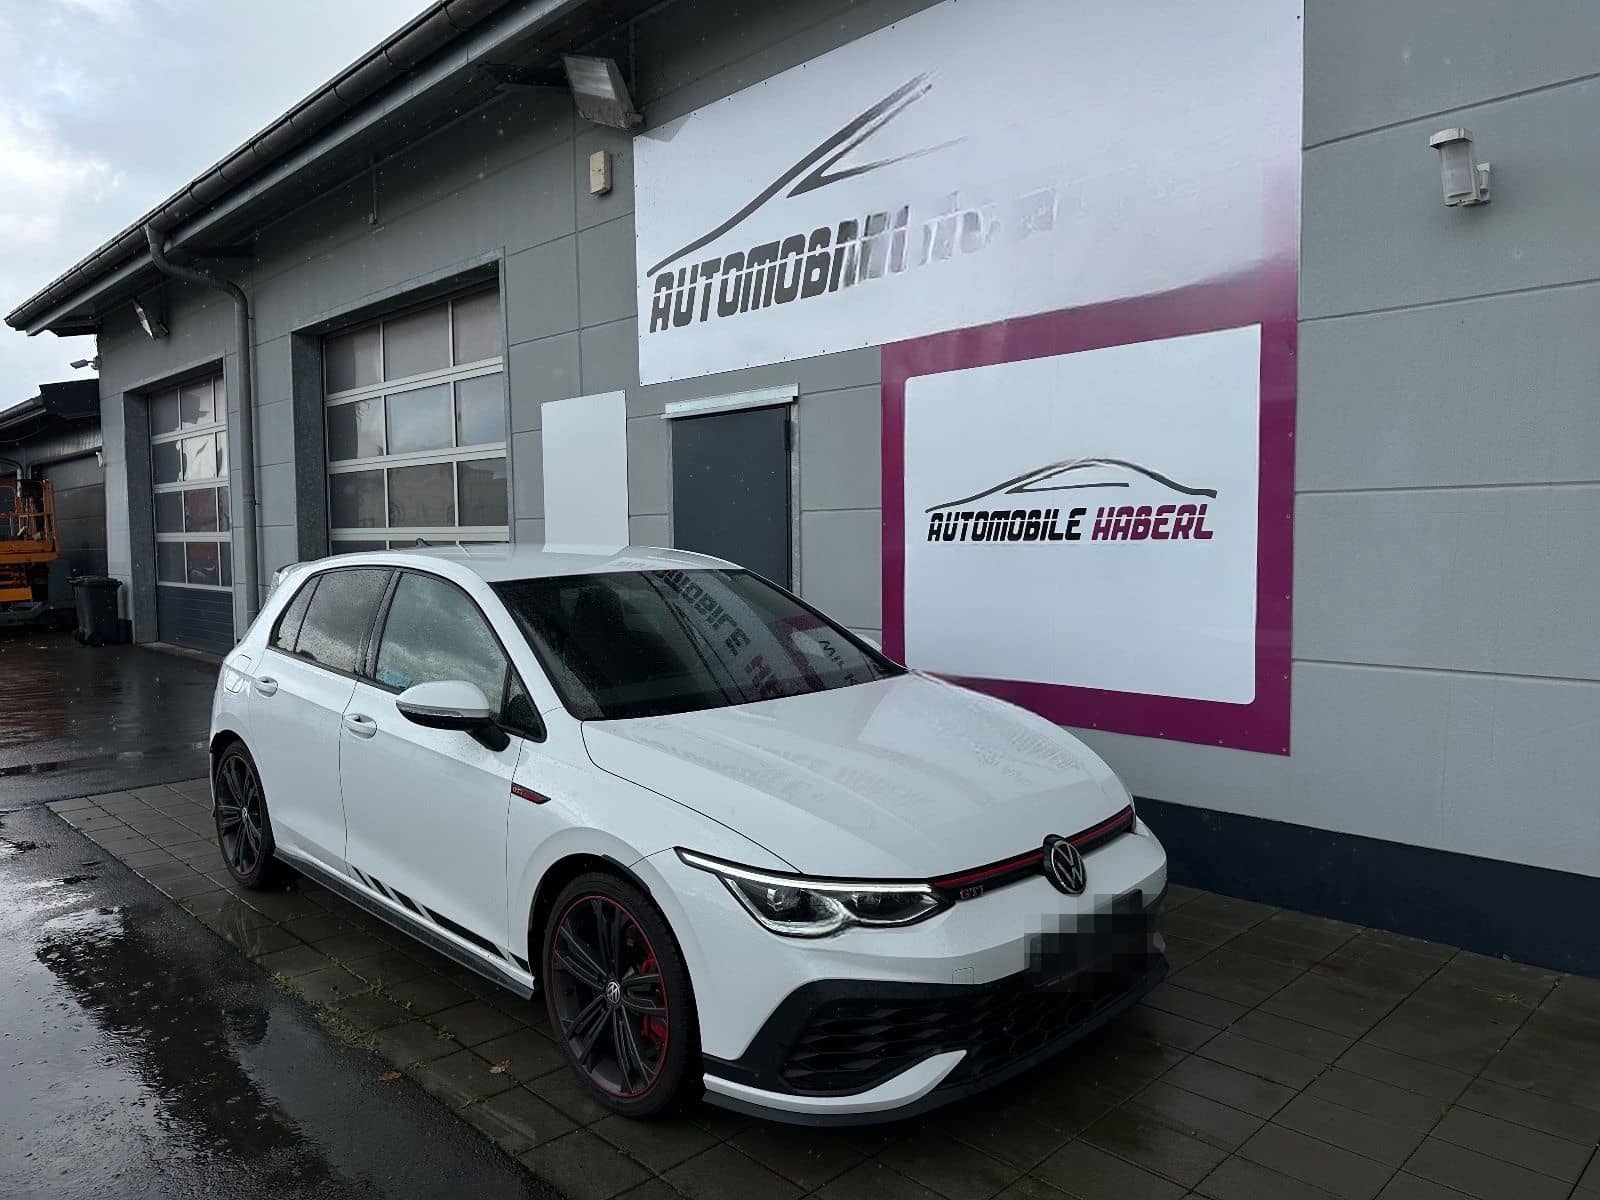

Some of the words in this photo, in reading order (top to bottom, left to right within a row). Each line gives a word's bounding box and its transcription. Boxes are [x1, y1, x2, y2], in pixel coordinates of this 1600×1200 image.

[927, 507, 1087, 541] AUTOMOBILE
[1091, 504, 1214, 540] HABERL
[960, 885, 984, 900] GTI
